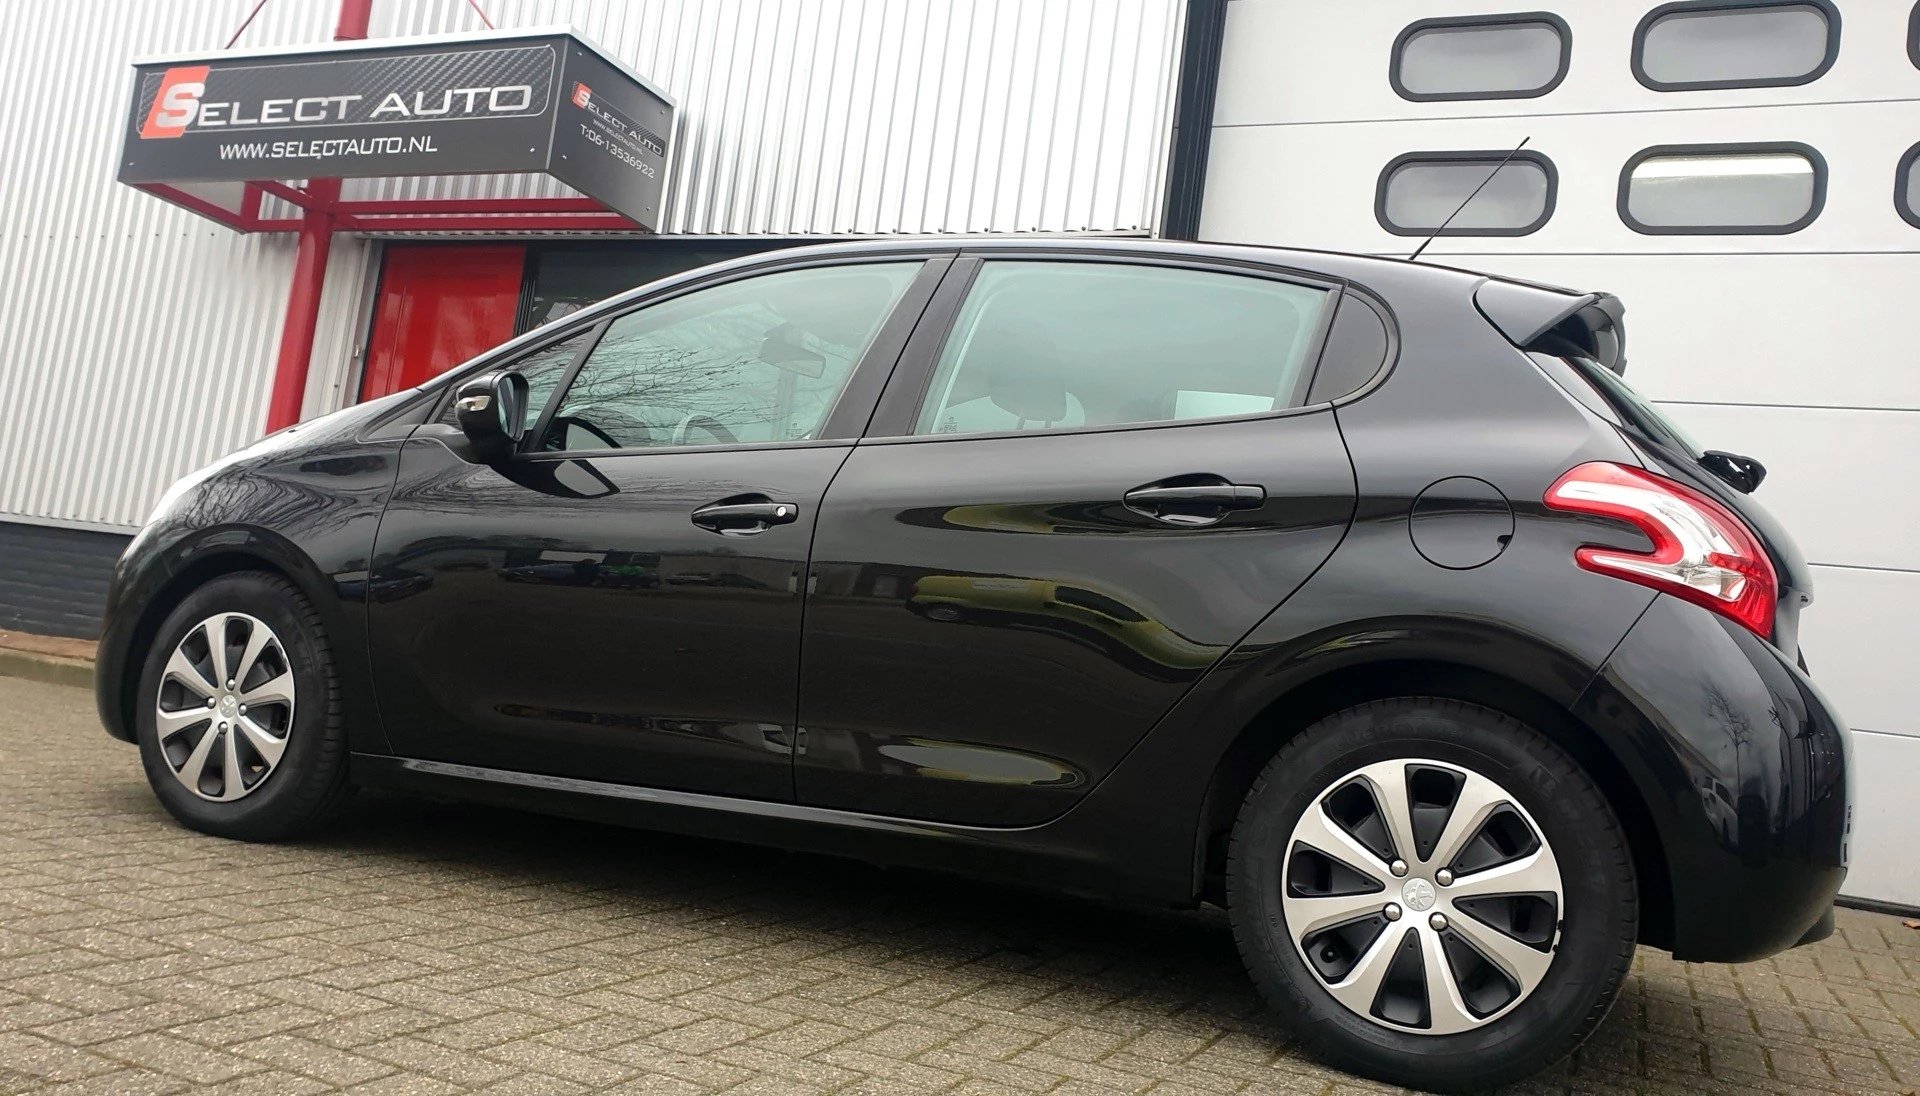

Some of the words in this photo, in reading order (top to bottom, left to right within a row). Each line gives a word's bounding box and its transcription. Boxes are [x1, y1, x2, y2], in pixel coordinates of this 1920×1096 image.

[155, 82, 363, 128] SELECT
[369, 85, 532, 118] AUTO
[577, 89, 628, 132] SELECT
[628, 130, 663, 155] AUTO
[219, 136, 438, 160] WWW.SELECTAUTO.NL
[580, 124, 655, 179] T:06-13536922
